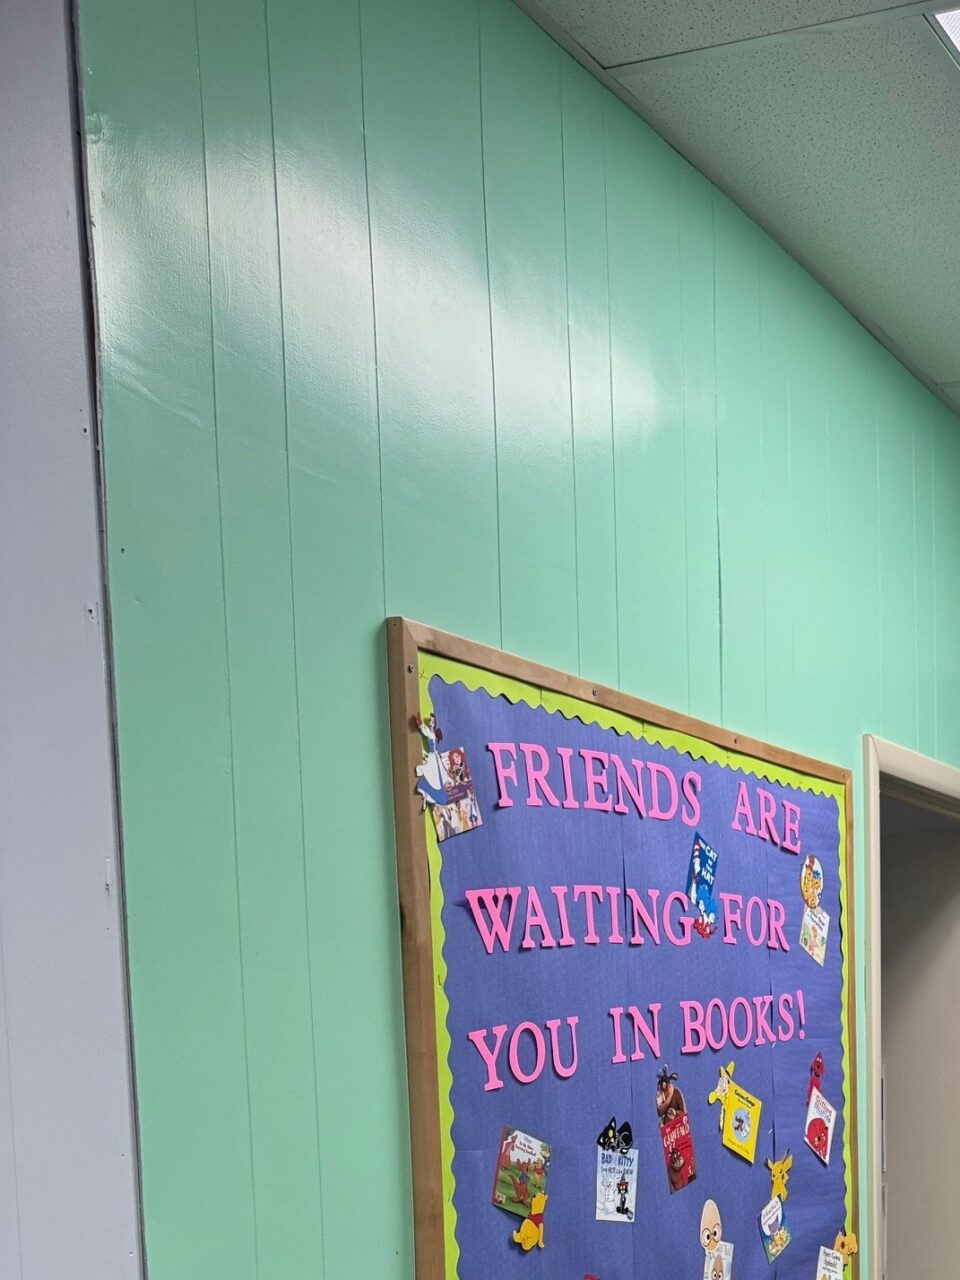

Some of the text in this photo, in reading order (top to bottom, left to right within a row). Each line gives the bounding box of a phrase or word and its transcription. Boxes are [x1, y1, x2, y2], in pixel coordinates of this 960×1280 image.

[488, 742, 801, 855] FRIENDS ARE
[465, 886, 790, 954] WAITING FOR
[468, 990, 807, 1091] YOU IN BOOKS!
[601, 1152, 634, 1167] BAD KITTY
